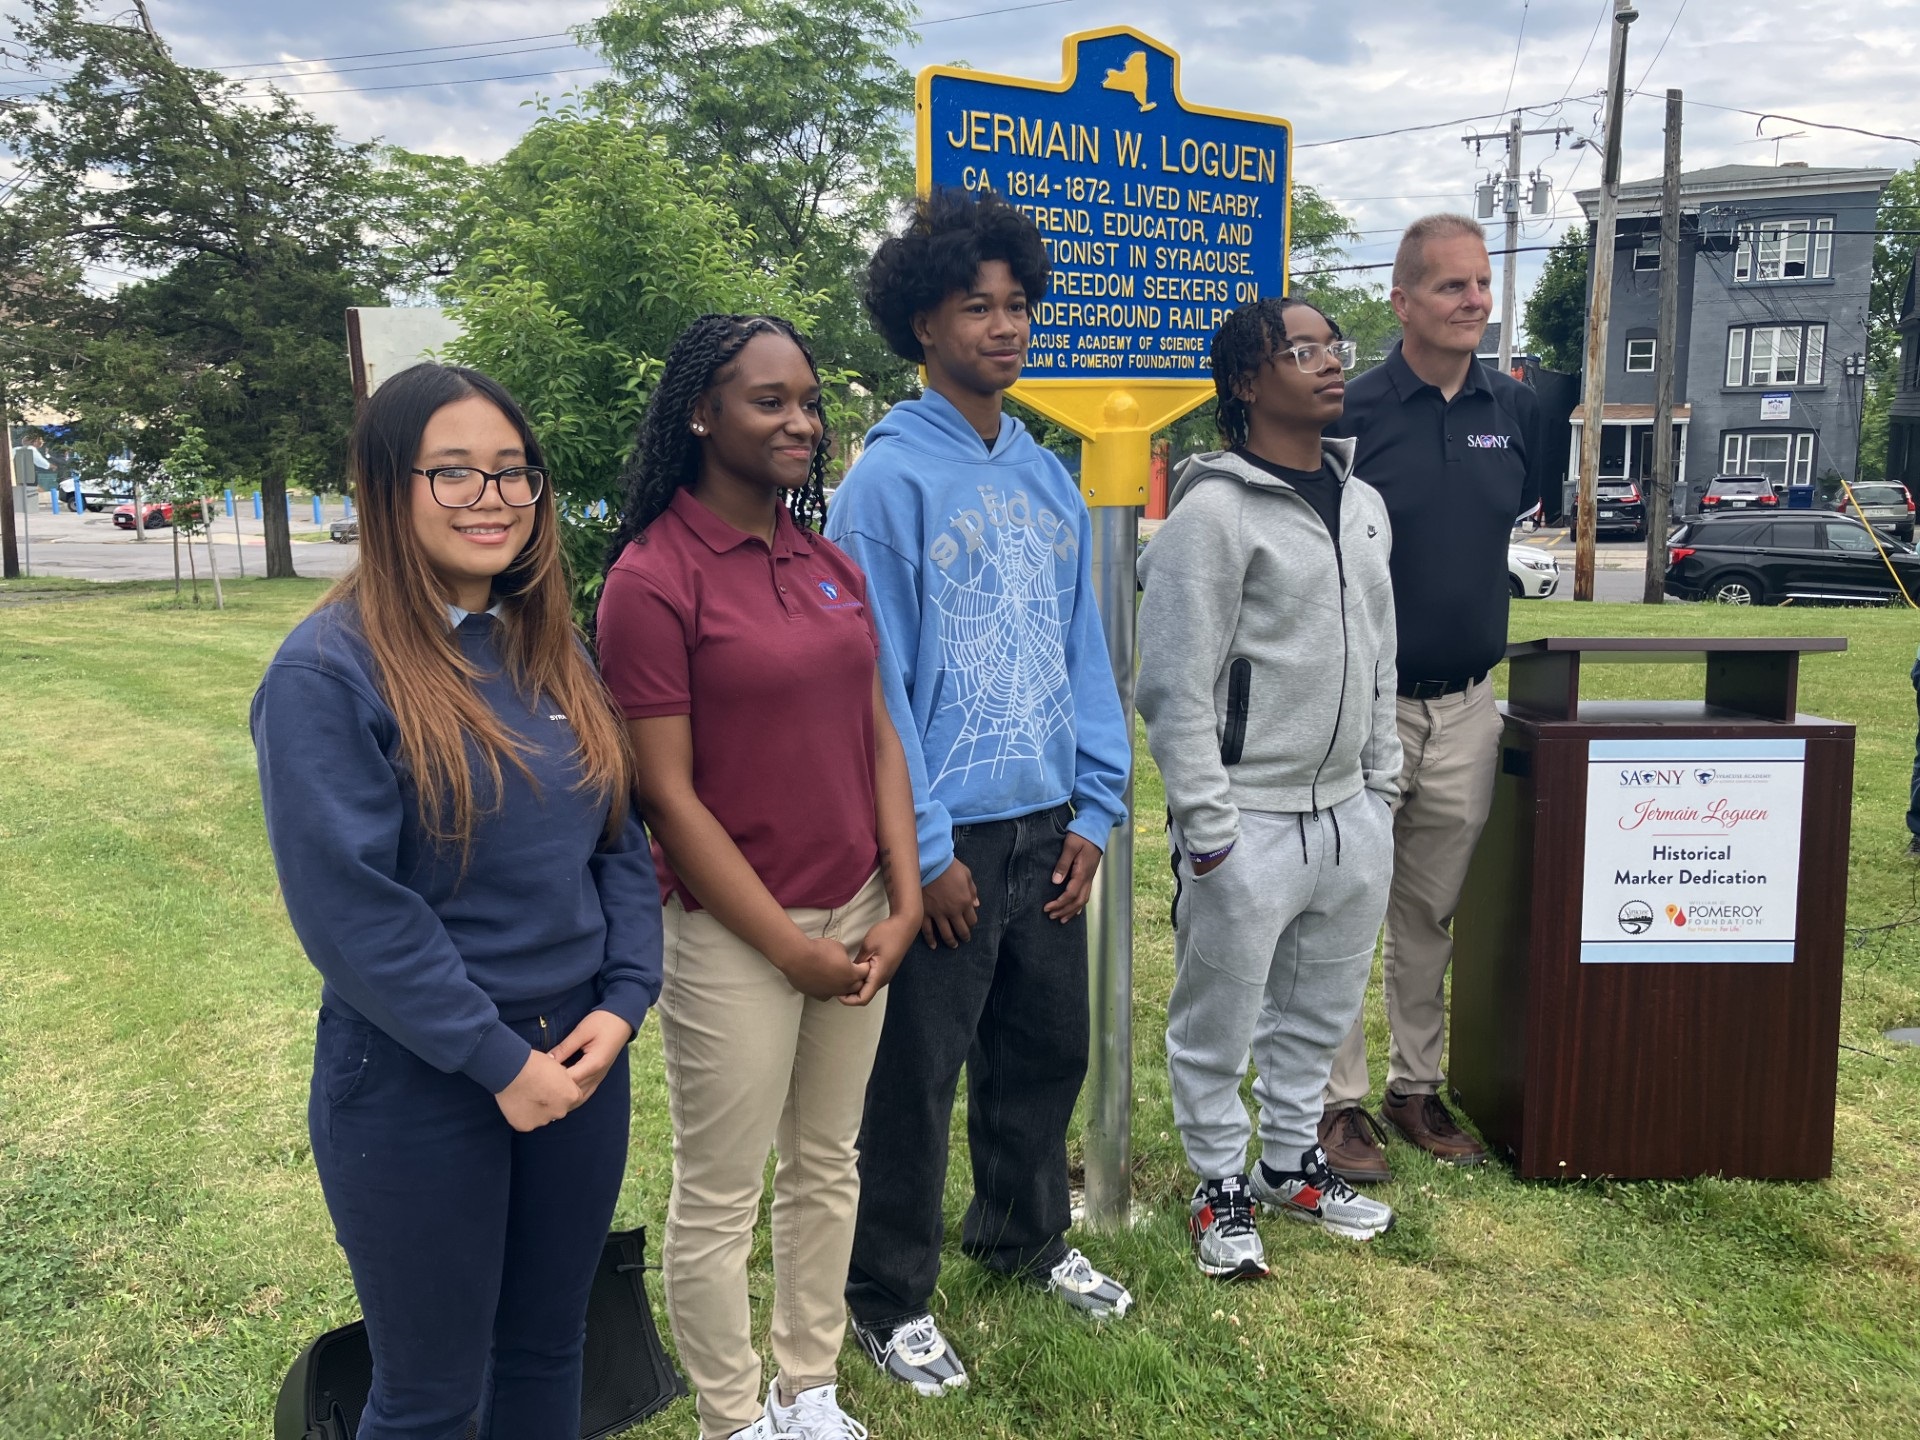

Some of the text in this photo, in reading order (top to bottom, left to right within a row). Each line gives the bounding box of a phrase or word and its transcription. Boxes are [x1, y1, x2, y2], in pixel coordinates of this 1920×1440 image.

[947, 109, 1275, 184] JERMAIN W. LOGUEN
[963, 166, 1263, 219] CA. 1814-1872. LIVED NEARBY.
[1103, 212, 1209, 245] EDUCATOR,
[1216, 222, 1253, 246] AND
[1129, 245, 1147, 267] IN
[1155, 246, 1254, 275] SYRACUSE.
[1046, 270, 1259, 303] REEDOM SEEKERS ON
[1029, 301, 1161, 329] NDERGROUND
[1027, 333, 1204, 351] ACUSE ACADEMY OF SCIENCE
[1057, 353, 1068, 368] G.
[1071, 353, 1124, 369] POMEROY
[1128, 354, 1195, 369] FOUNDATION
[1619, 798, 1769, 830] Jermain Loguen
[1652, 845, 1731, 861] Historical
[1614, 869, 1767, 885] Marker Dedication
[1688, 905, 1763, 918] POMEROY
